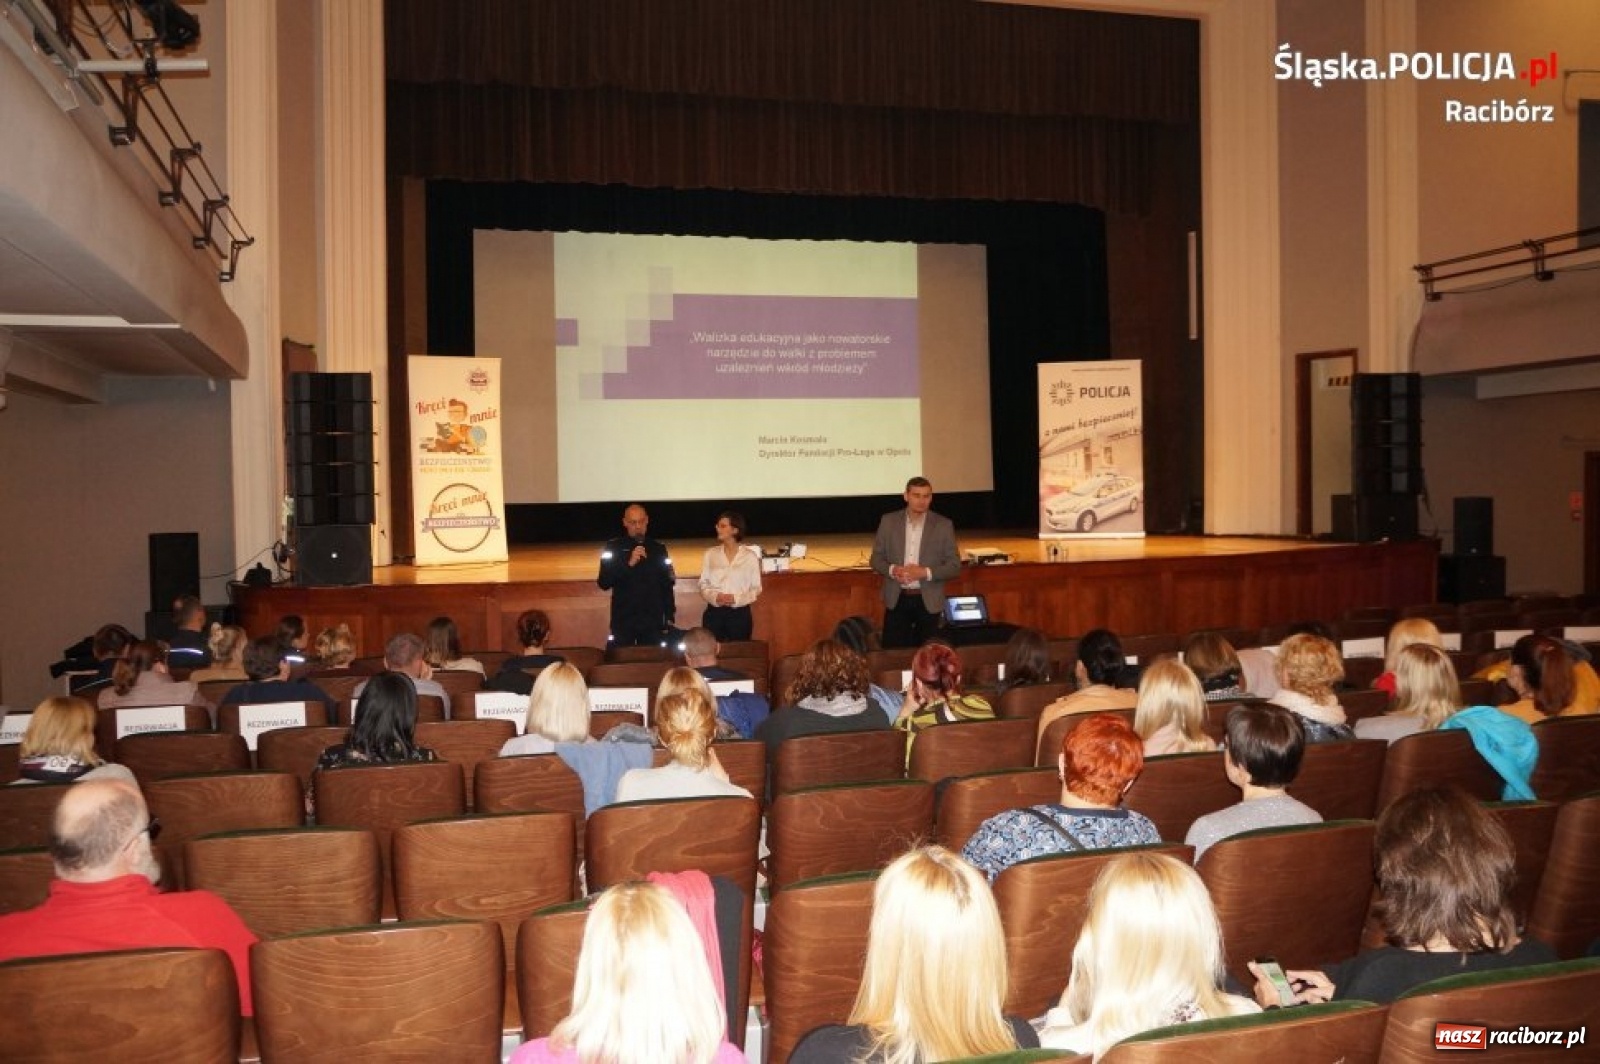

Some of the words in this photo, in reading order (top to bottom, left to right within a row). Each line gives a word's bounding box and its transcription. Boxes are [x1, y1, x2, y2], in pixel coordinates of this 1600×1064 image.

[740, 332, 801, 345] edukacyjna
[762, 347, 776, 358] do
[1079, 385, 1131, 399] POLICJA
[123, 722, 178, 732] REZERWACJA
[247, 718, 300, 729] REZERWACJA
